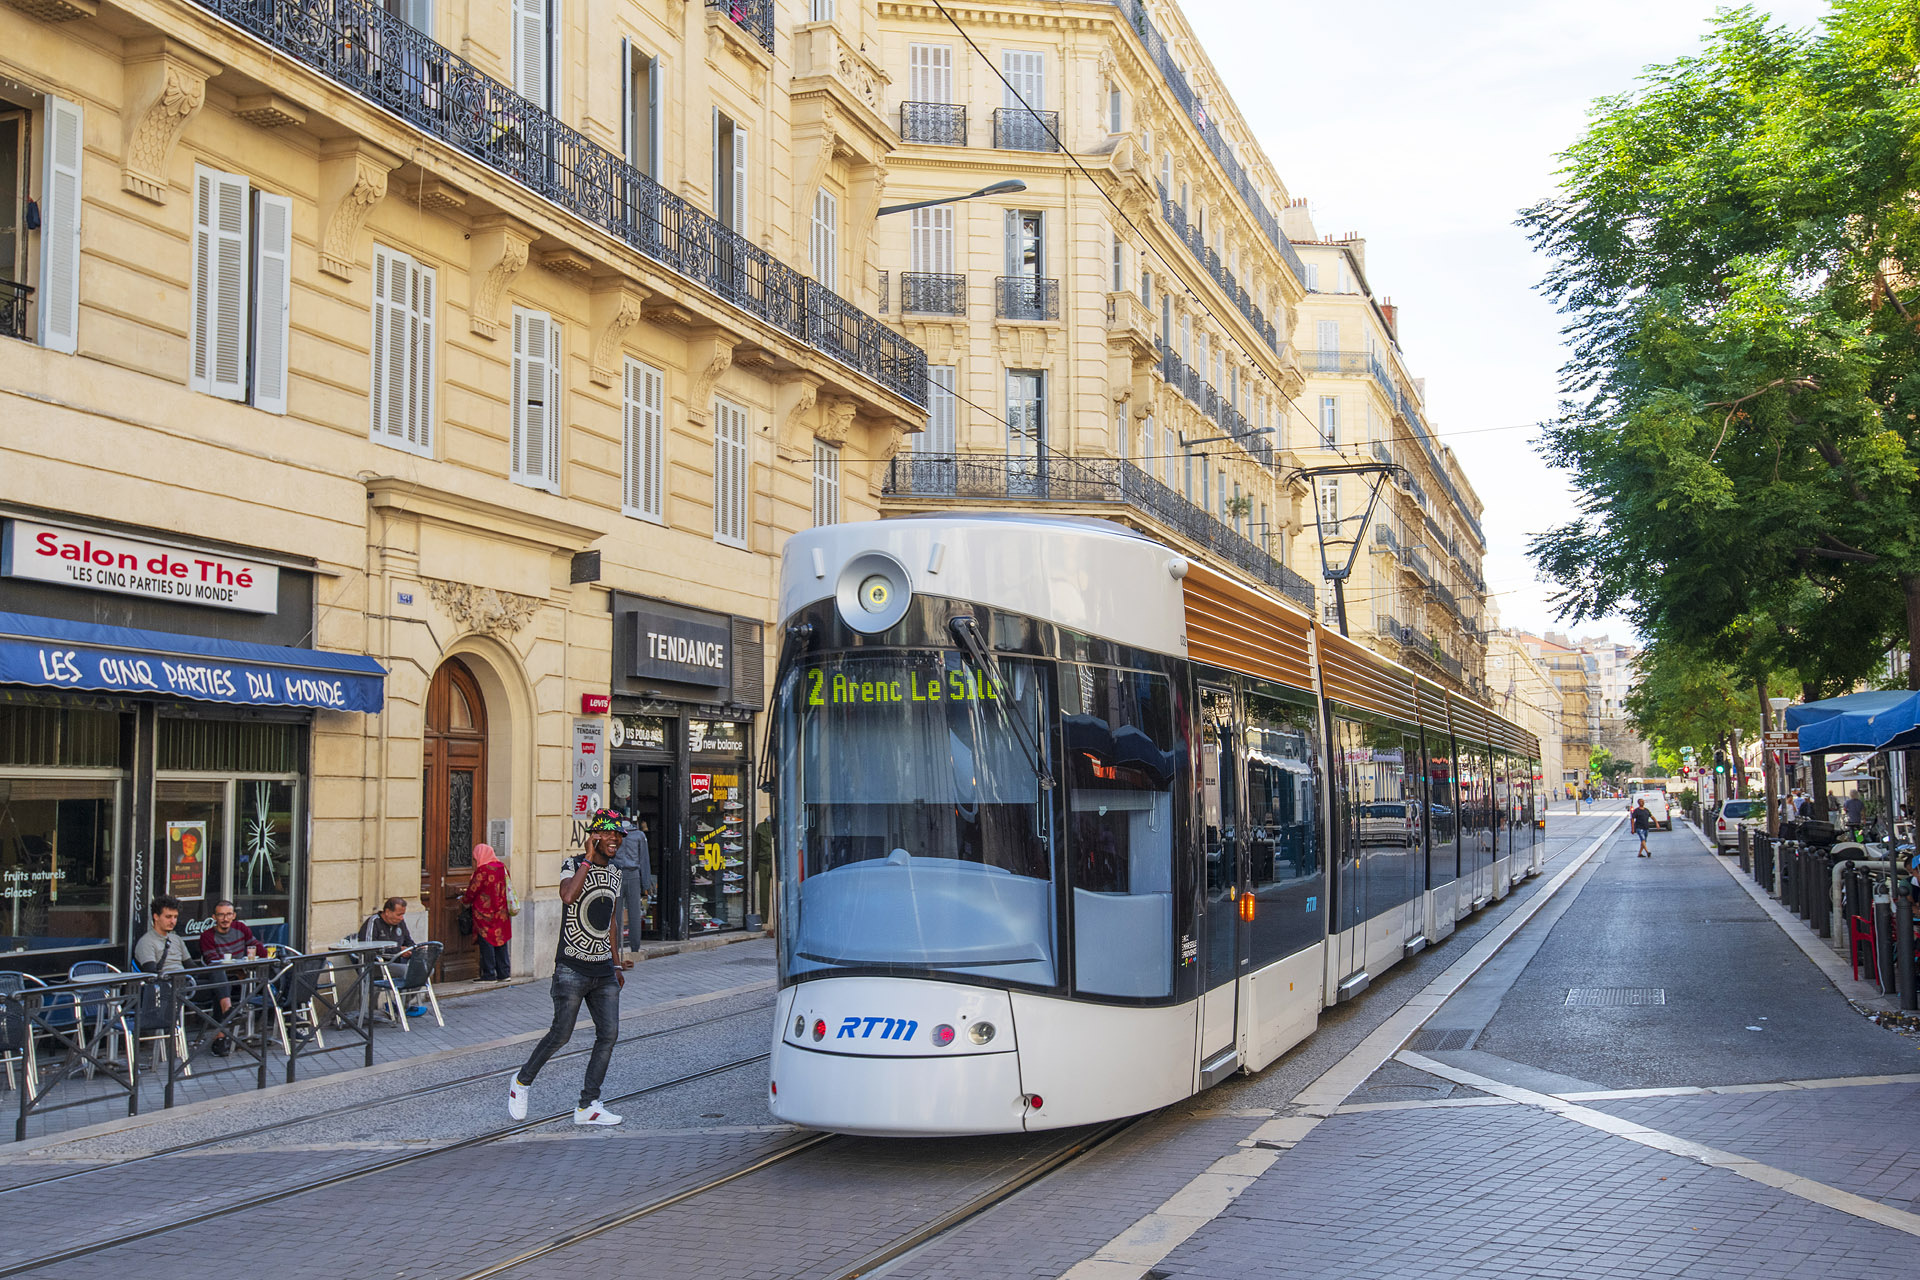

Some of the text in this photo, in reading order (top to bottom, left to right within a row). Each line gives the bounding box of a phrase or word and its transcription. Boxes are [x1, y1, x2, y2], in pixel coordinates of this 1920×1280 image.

[35, 531, 254, 588] Salon de Thé
[66, 565, 239, 602] "LES CINQ PARTIES DU MONDE"
[646, 631, 724, 669] TENDANCE
[39, 650, 346, 706] LES CINQ PARTIES DU MONDE
[808, 668, 825, 706] 2
[833, 673, 903, 703] Arenc
[911, 671, 941, 701] Le
[576, 727, 601, 736] TENDANCE
[703, 739, 743, 751] new balance
[3, 869, 66, 882] fruits naturels
[836, 1016, 919, 1042] RTM
